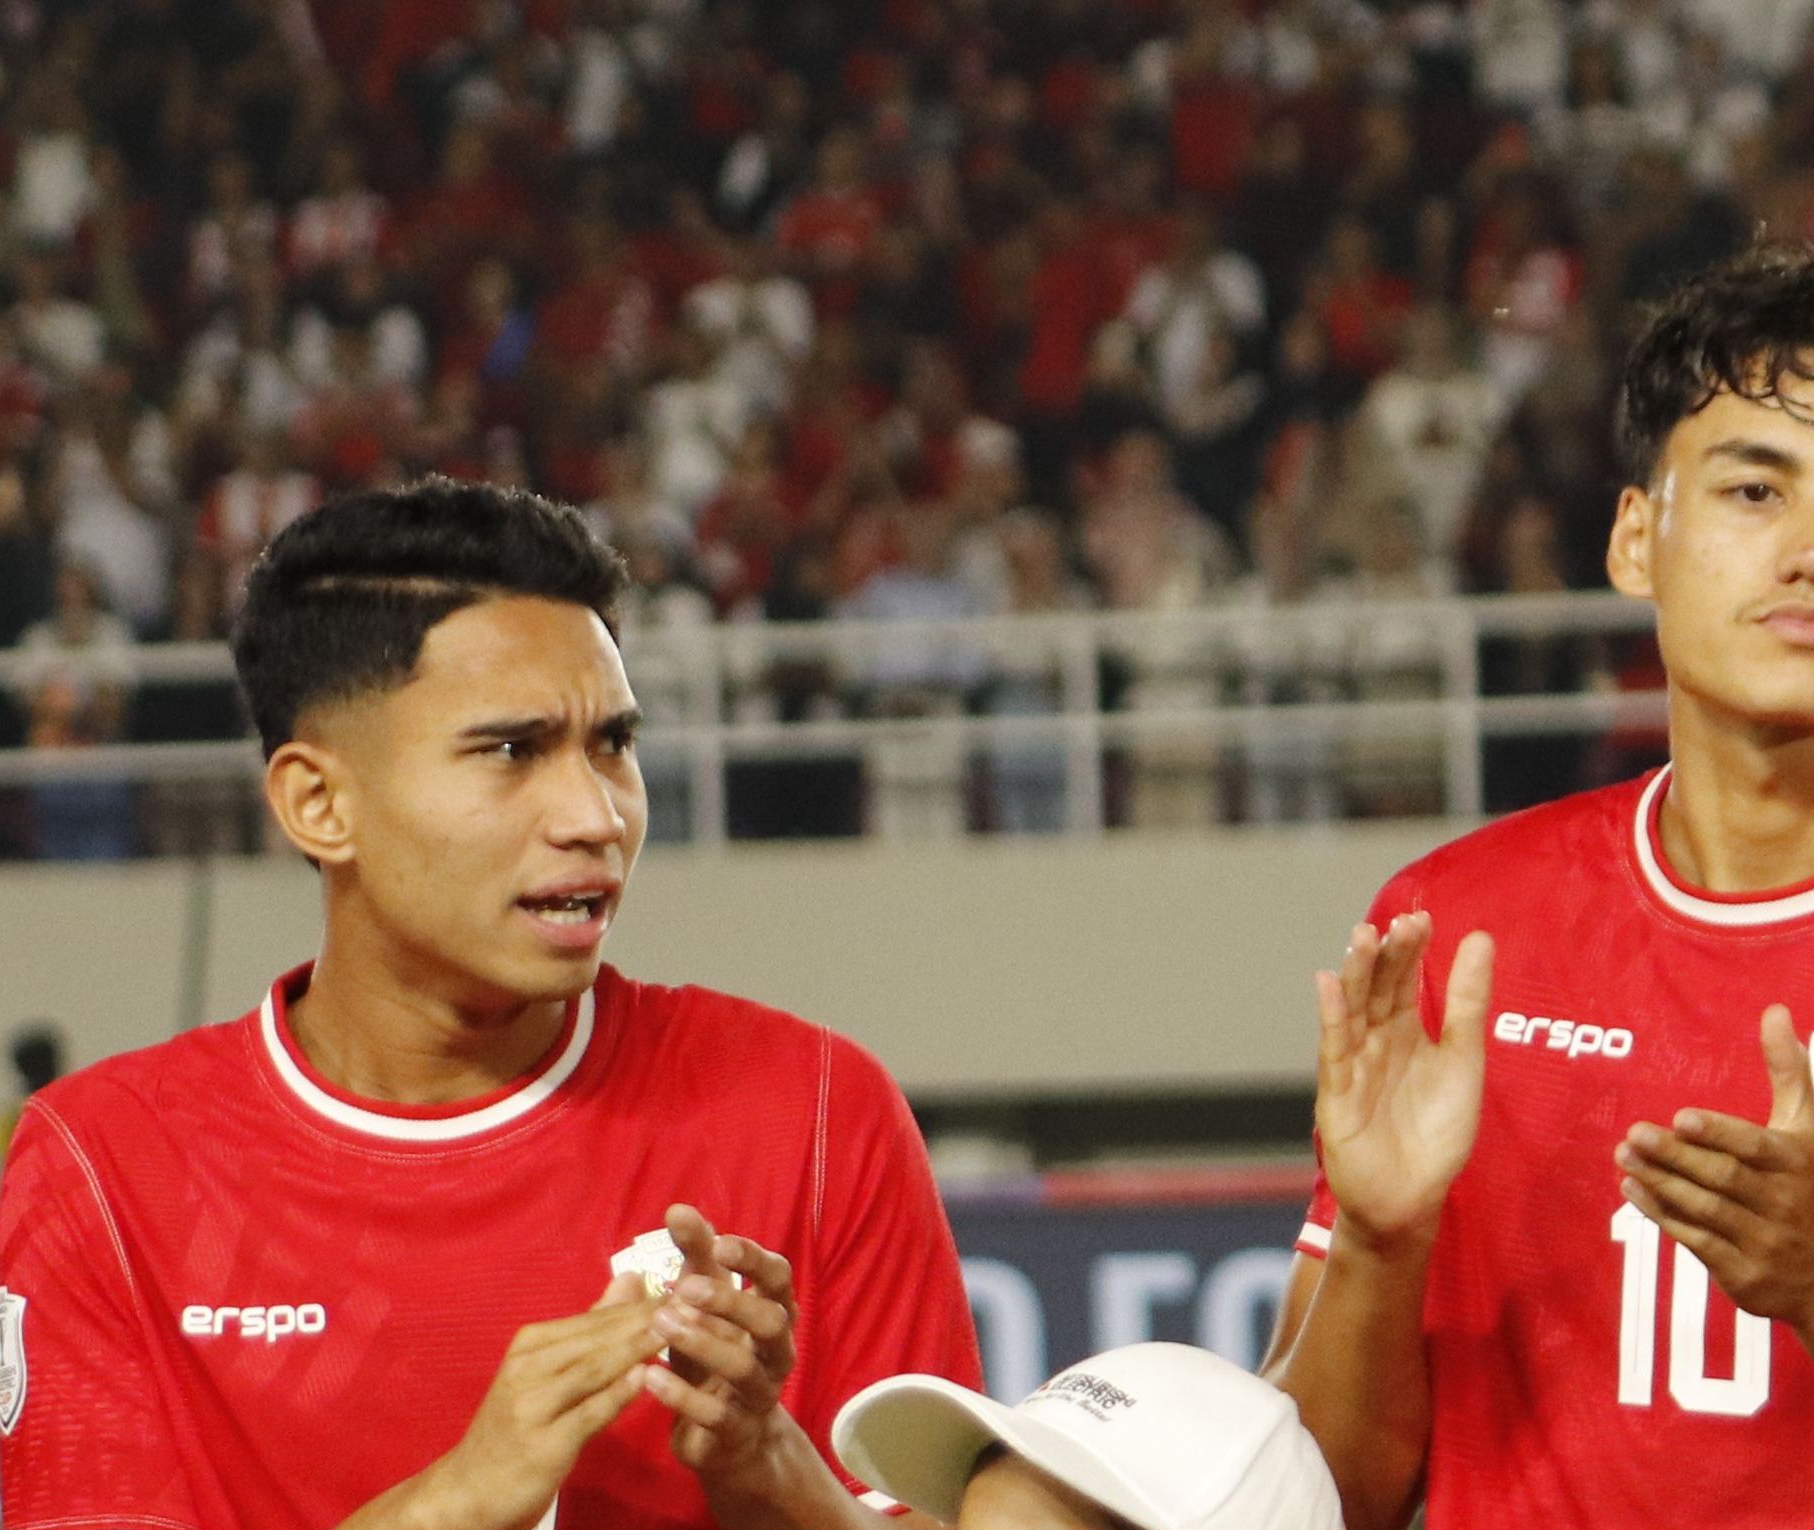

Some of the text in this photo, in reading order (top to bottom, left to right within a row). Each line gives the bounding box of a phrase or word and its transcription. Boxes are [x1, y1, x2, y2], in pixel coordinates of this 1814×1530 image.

[1493, 1011, 1635, 1060] erspo
[181, 1302, 326, 1345] erspo
[1610, 1200, 1772, 1418] 10
